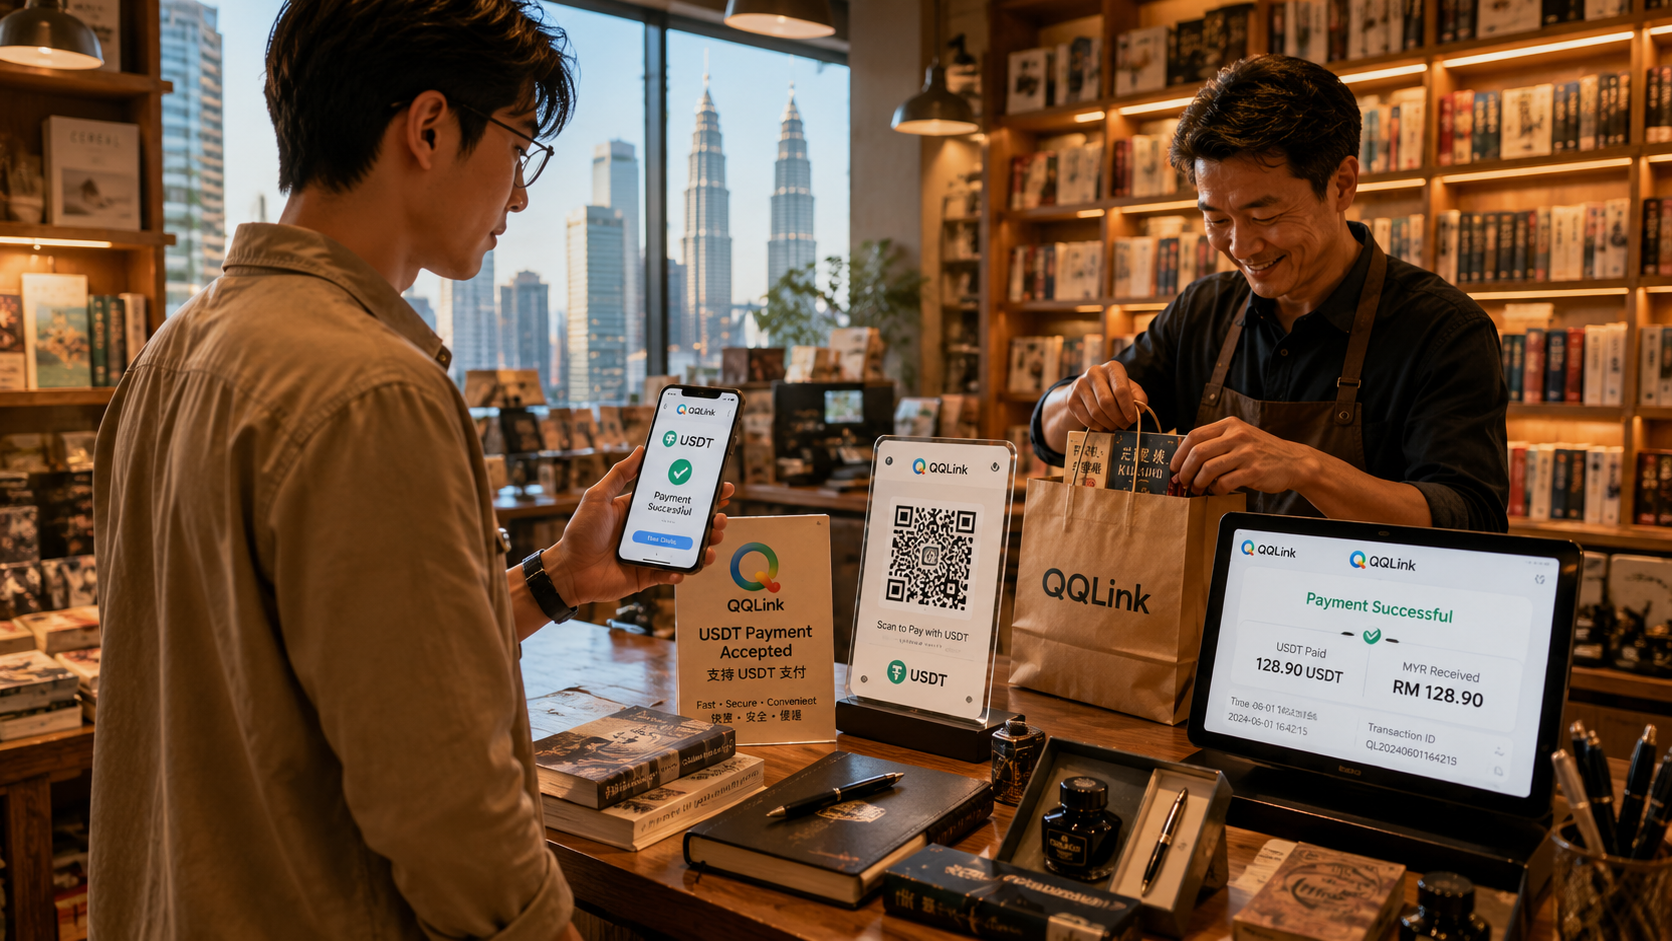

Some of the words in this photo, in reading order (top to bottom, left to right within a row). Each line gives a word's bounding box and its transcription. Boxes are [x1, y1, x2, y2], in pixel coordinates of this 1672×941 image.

[680, 434, 715, 449] USDT
[929, 462, 968, 476] QQLink
[654, 490, 692, 504] Payment
[1257, 543, 1297, 559] QQLink
[1369, 555, 1416, 572] QQLink
[1042, 567, 1152, 615] QQLink
[727, 598, 785, 613] QQLink
[1306, 591, 1369, 613] Payment
[1372, 600, 1454, 624] Successful
[699, 627, 742, 641] USDT
[746, 625, 813, 642] Payment
[877, 620, 896, 631] Scan
[898, 624, 906, 632] to
[908, 625, 924, 637] Pay
[925, 628, 942, 638] with
[944, 630, 969, 642] USDT
[720, 644, 793, 661] Accepted
[1276, 642, 1303, 656] USDT
[1304, 646, 1327, 659] Paid
[738, 667, 776, 680] USDT
[779, 665, 806, 679] 支付
[910, 669, 948, 687] USDT
[1256, 656, 1303, 677] 128.90
[1306, 665, 1344, 684] USDT
[1402, 662, 1428, 676] MYR
[1430, 666, 1481, 684] Received
[1393, 679, 1420, 698] RM
[1424, 684, 1484, 708] 128.90
[696, 700, 716, 710] Fast
[726, 698, 758, 708] Secure
[746, 710, 767, 722] 安全
[1368, 722, 1423, 742] Transaction
[1425, 734, 1436, 744] ID
